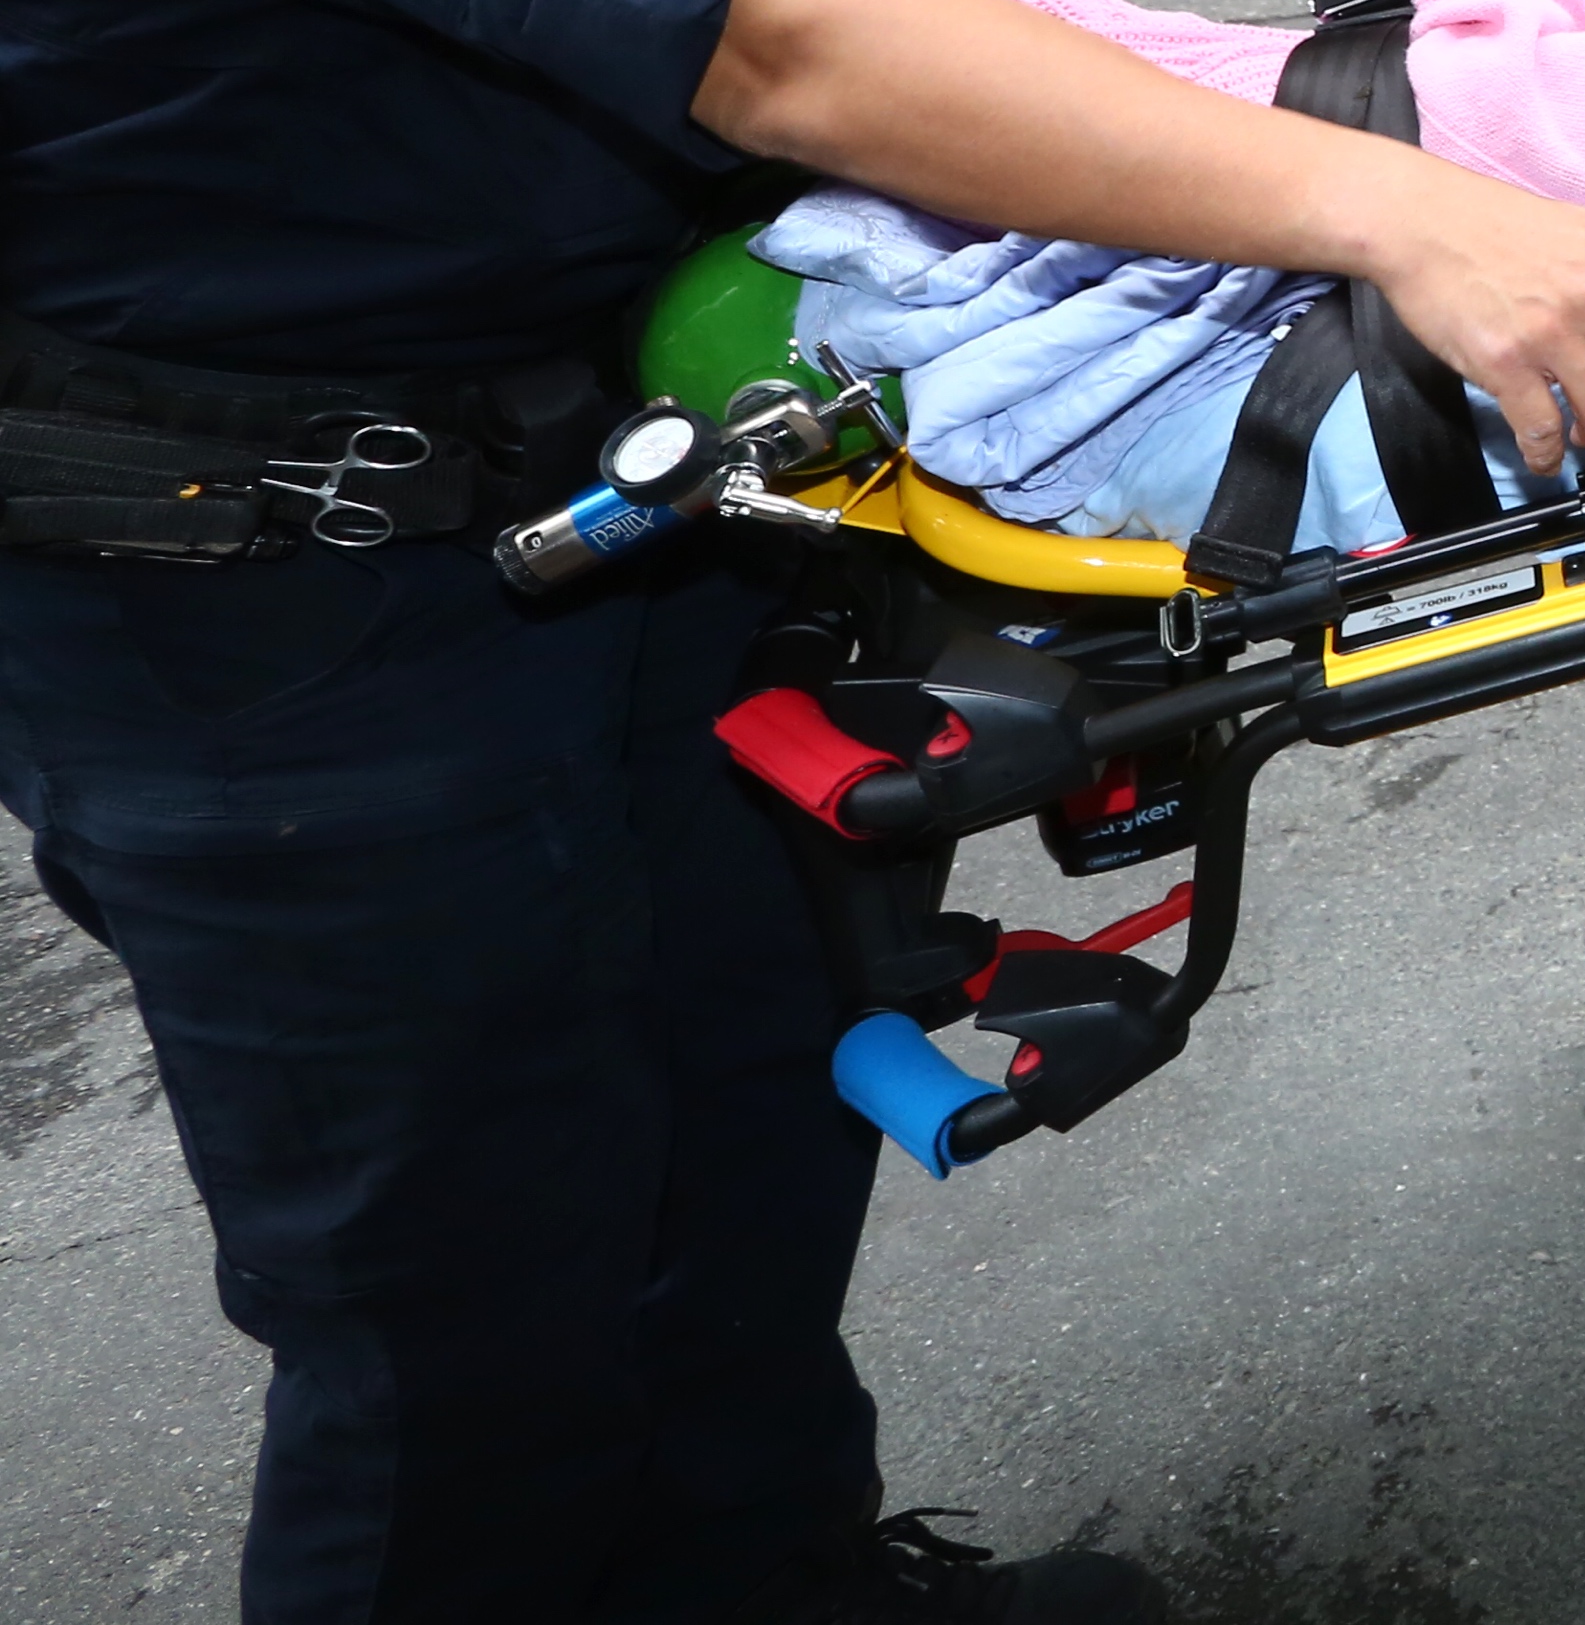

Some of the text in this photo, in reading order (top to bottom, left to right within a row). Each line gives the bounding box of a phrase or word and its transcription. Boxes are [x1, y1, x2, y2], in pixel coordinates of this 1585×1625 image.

[588, 506, 655, 551] Allied
[1419, 594, 1457, 610] 700lb
[1468, 580, 1509, 598] 318kg
[1081, 800, 1180, 840] yker
